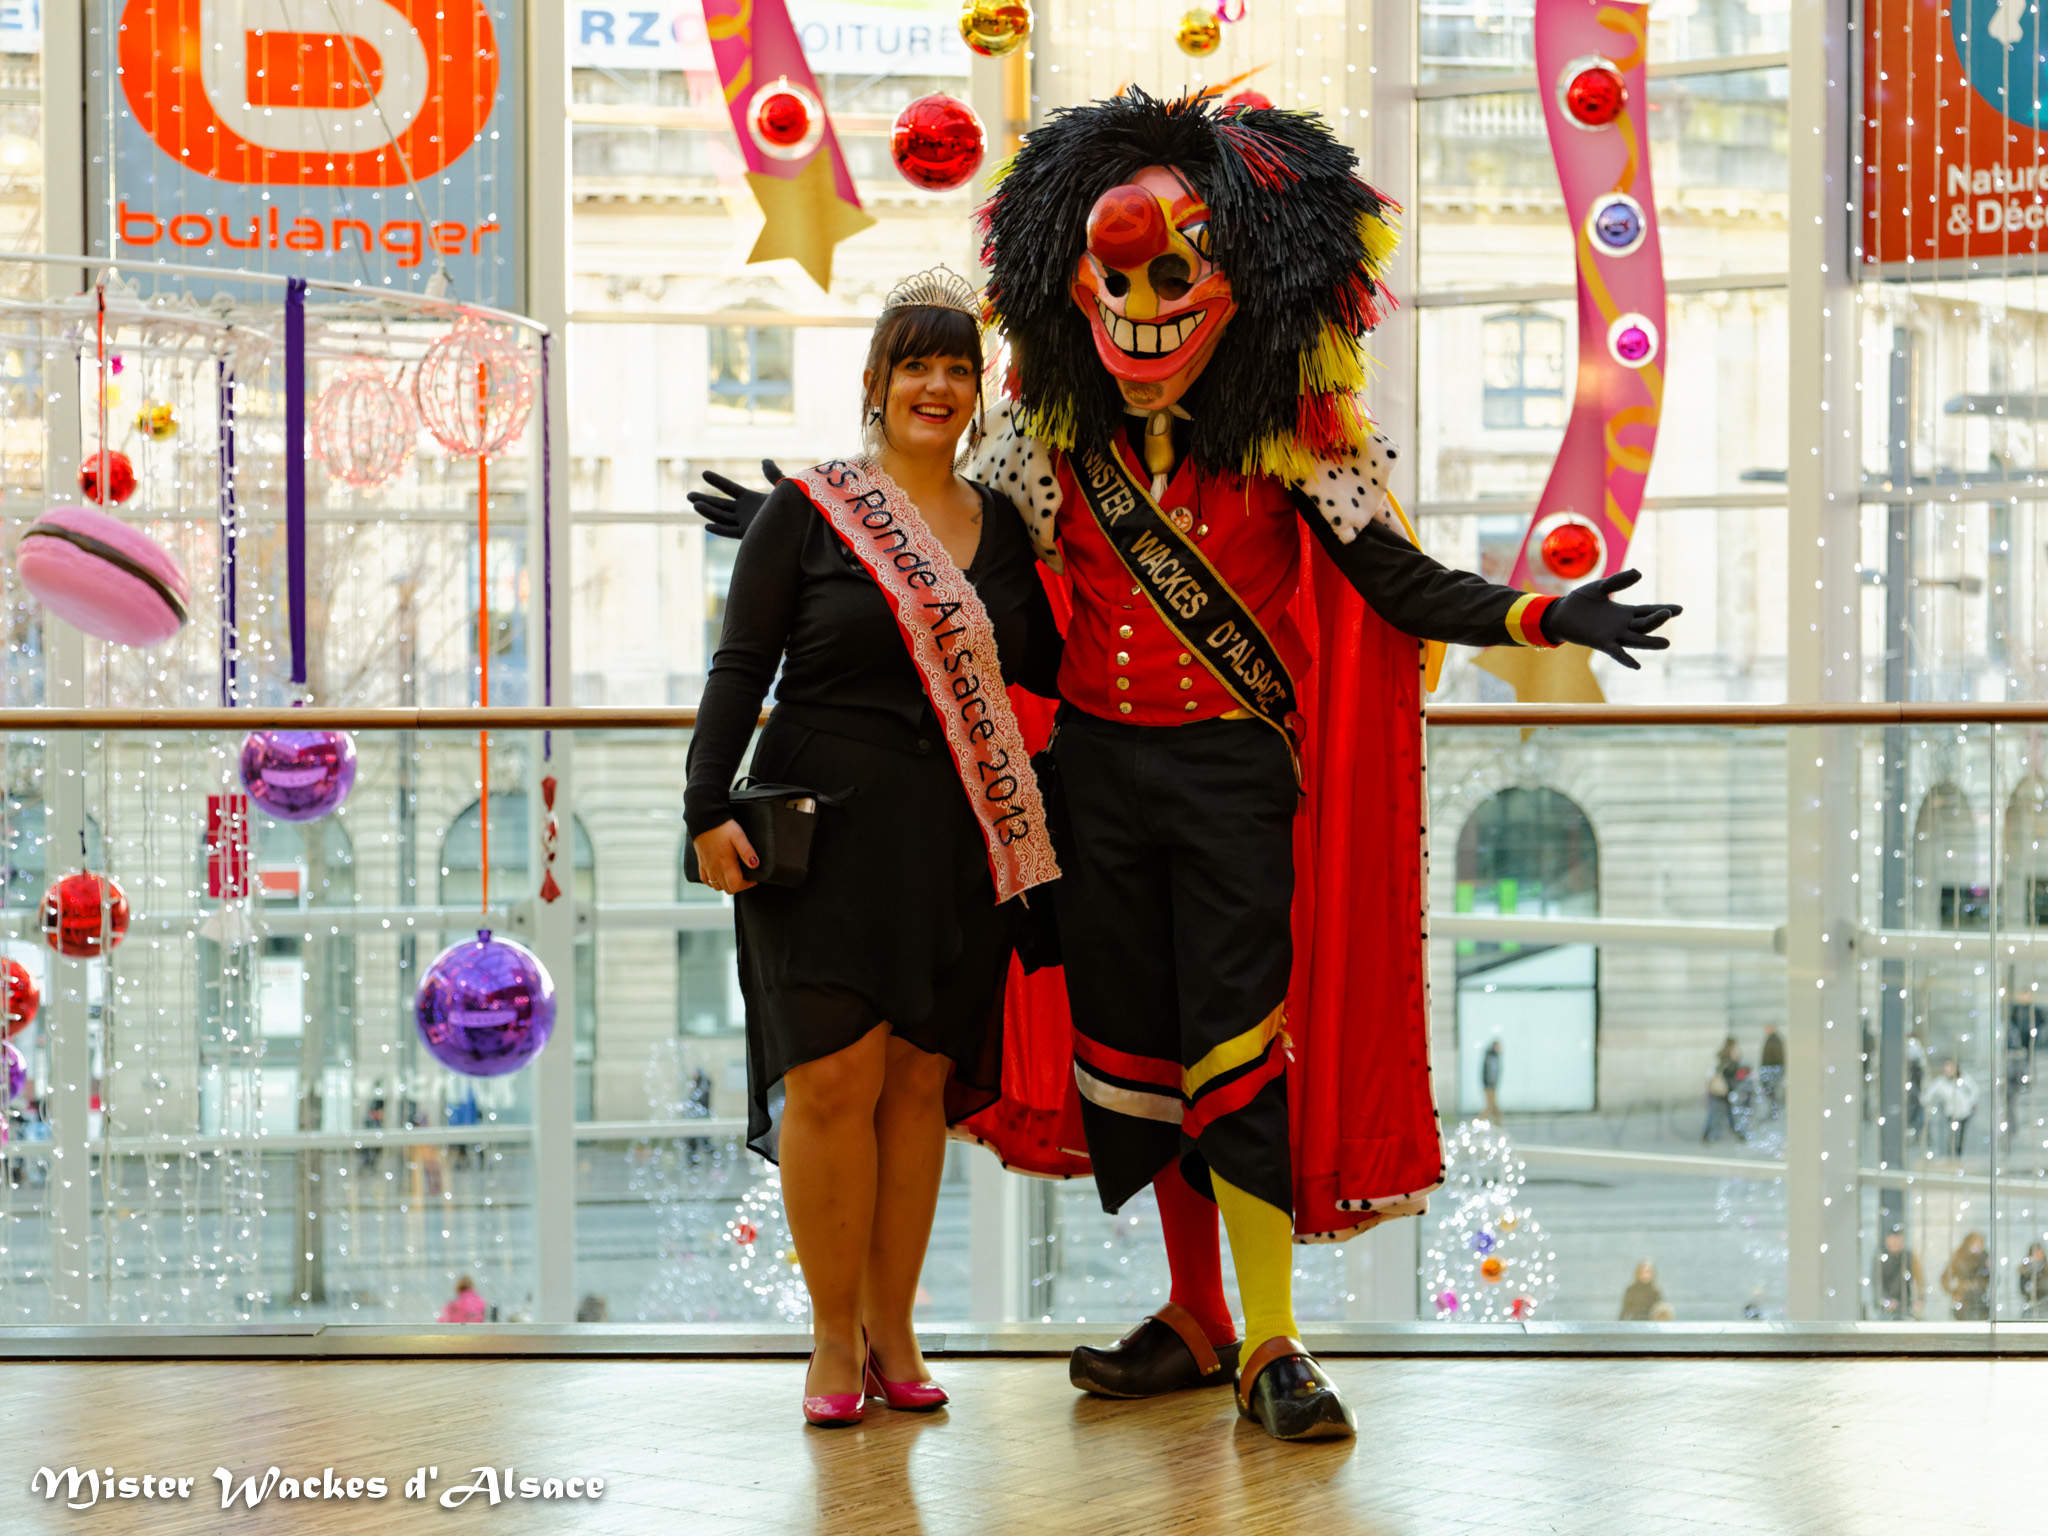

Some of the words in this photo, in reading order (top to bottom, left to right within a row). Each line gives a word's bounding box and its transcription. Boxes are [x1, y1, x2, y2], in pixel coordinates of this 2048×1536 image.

[800, 22, 963, 55] OITURE
[118, 201, 501, 268] boulanger
[1946, 203, 1972, 236] &
[1977, 197, 2048, 233] Déc
[812, 459, 859, 488] SS
[845, 489, 937, 590] Ronde
[977, 749, 1029, 848] 2013
[1130, 529, 1209, 620] WACKES
[1206, 620, 1288, 715] D'ALSACE
